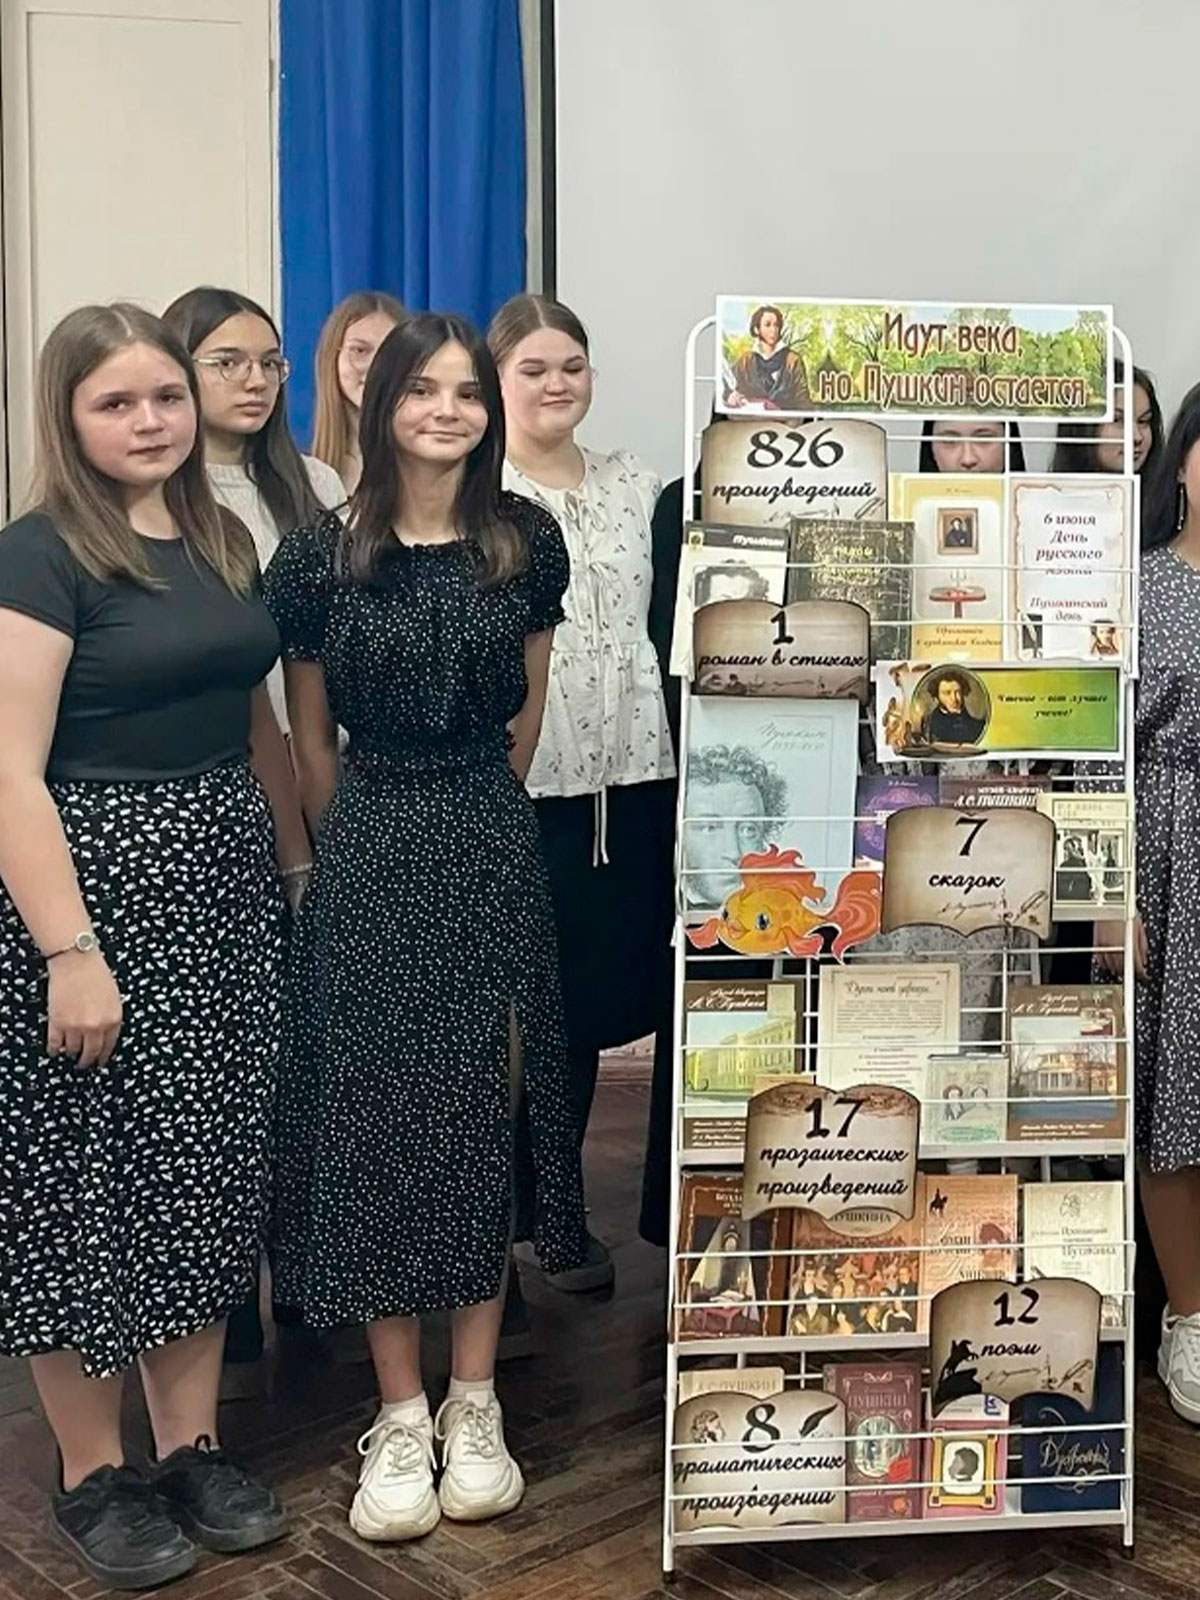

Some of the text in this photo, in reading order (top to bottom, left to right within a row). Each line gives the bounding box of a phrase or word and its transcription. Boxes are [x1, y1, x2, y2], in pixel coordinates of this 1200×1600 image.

[883, 312, 1023, 358] Идут века,
[820, 363, 1086, 407] но Пушкин остается
[747, 427, 844, 468] 826
[712, 477, 877, 505] произведений
[1043, 512, 1097, 525] 6 июня
[1049, 530, 1088, 544] День
[1036, 549, 1103, 561] русского
[1030, 597, 1108, 609] Пушкинский
[770, 610, 794, 645] 1
[699, 649, 868, 670] роман в стихах
[955, 817, 988, 856] 7
[928, 873, 1005, 894] сказок
[804, 1098, 866, 1139] 17
[760, 1147, 909, 1169] прозаических
[757, 1173, 908, 1203] произведений
[993, 1288, 1040, 1326] 12
[980, 1342, 1042, 1356] поэм
[741, 1403, 781, 1454] 8
[672, 1455, 847, 1483] драматических
